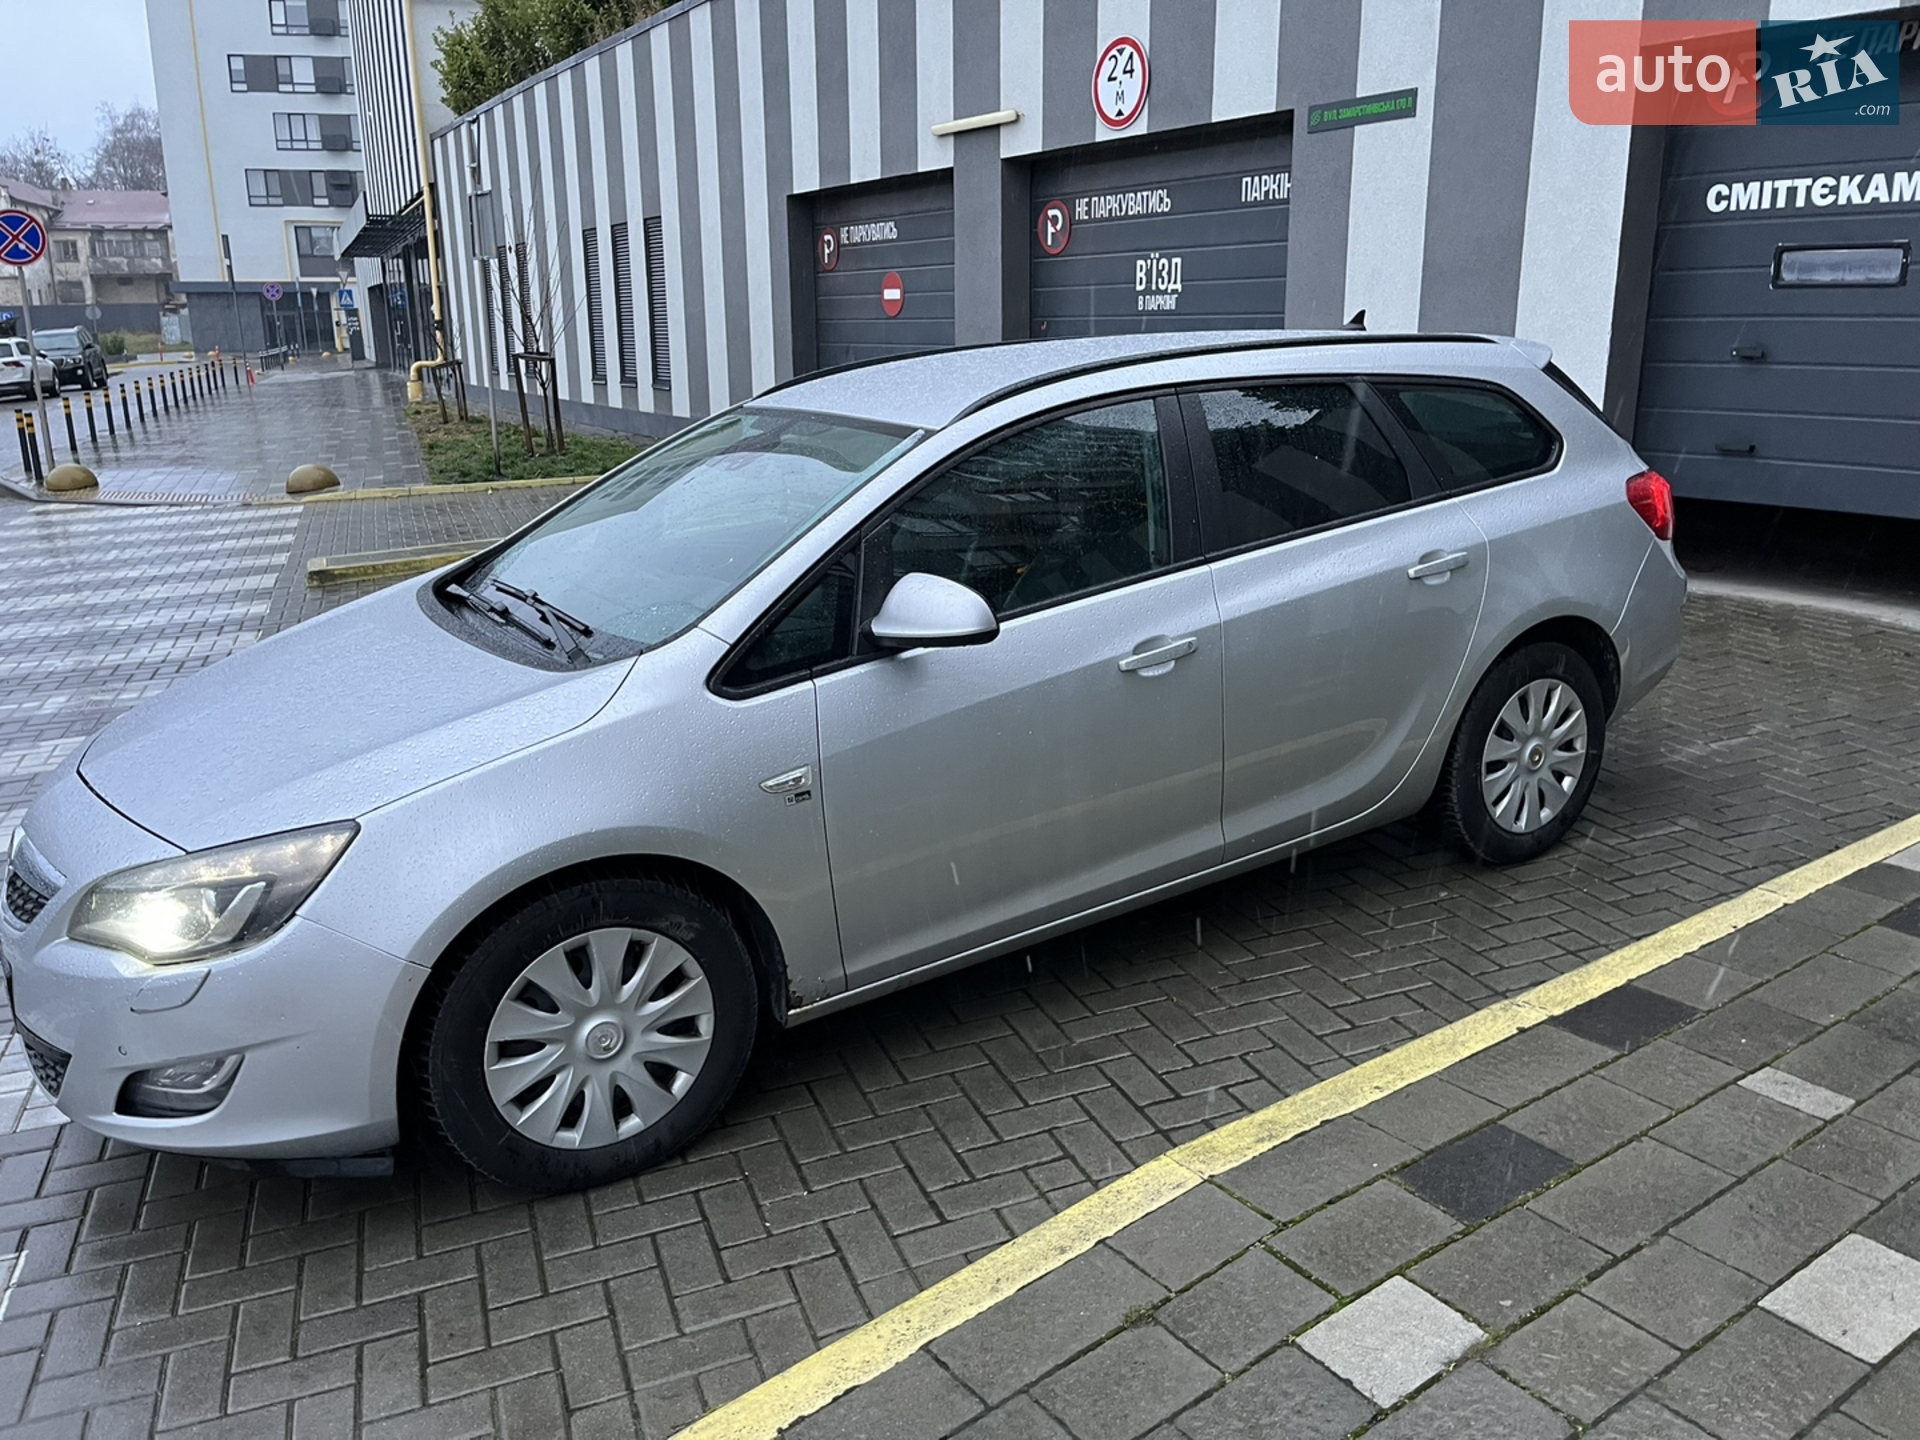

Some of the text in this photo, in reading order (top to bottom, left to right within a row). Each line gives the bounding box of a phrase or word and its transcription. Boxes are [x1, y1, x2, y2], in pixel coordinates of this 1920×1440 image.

[1075, 188, 1171, 220] НЕ ПАРКУВАТИСЬ
[1706, 170, 1920, 212] СМІТТЄКАМ
[840, 221, 898, 244] НЕ ПАРКУВАТИСЬ
[1138, 294, 1178, 311] В ПАРКІНГ
